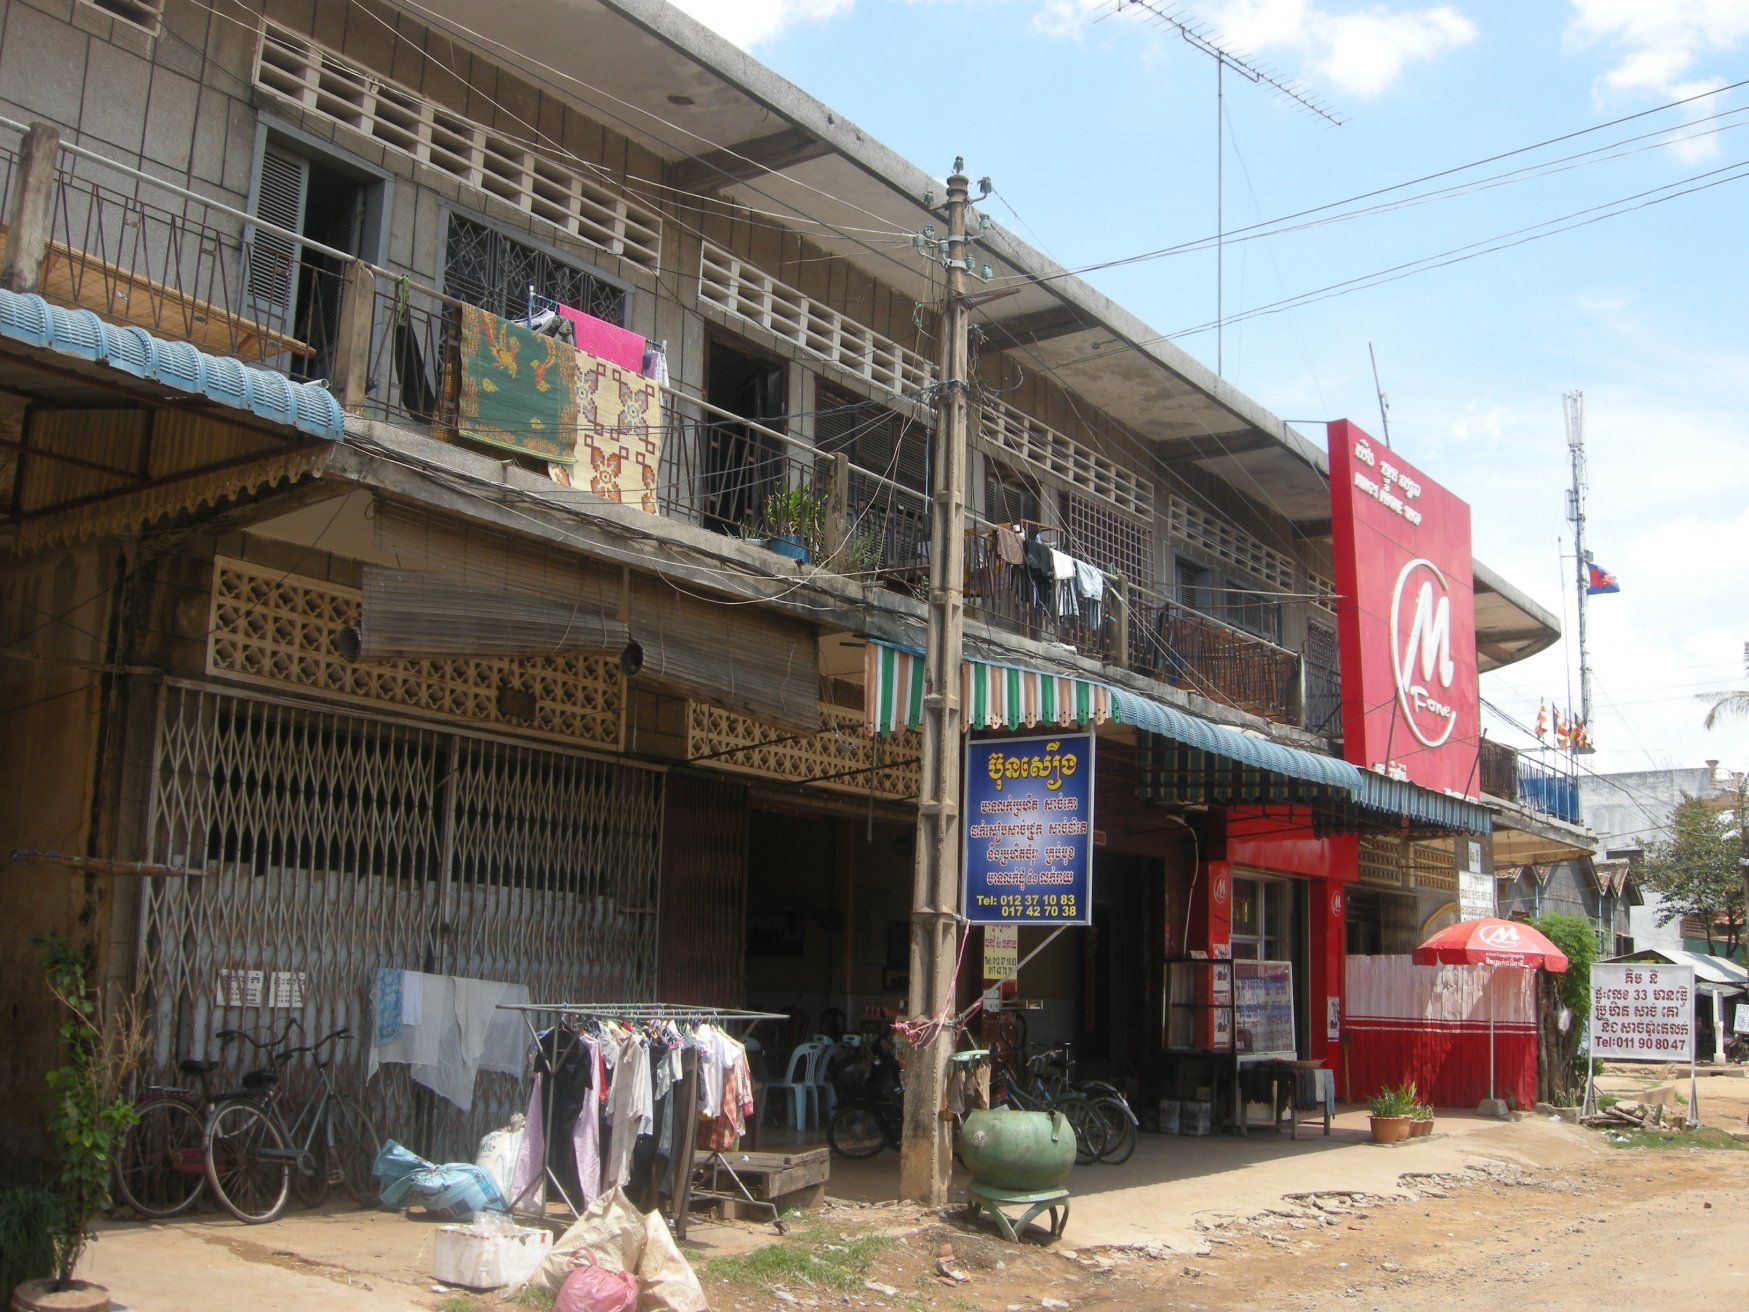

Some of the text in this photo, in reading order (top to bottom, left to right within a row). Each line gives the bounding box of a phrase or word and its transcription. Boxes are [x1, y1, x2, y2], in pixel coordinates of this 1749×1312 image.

[1410, 684, 1451, 718] Fone
[976, 894, 1076, 906] Tel: 012 37 10 83
[1001, 905, 1077, 917] 017 42 70 38
[1634, 989, 1648, 1001] 33
[1638, 1037, 1653, 1049] 90
[1655, 1038, 1669, 1049] 80
[1671, 1039, 1686, 1051] 47
